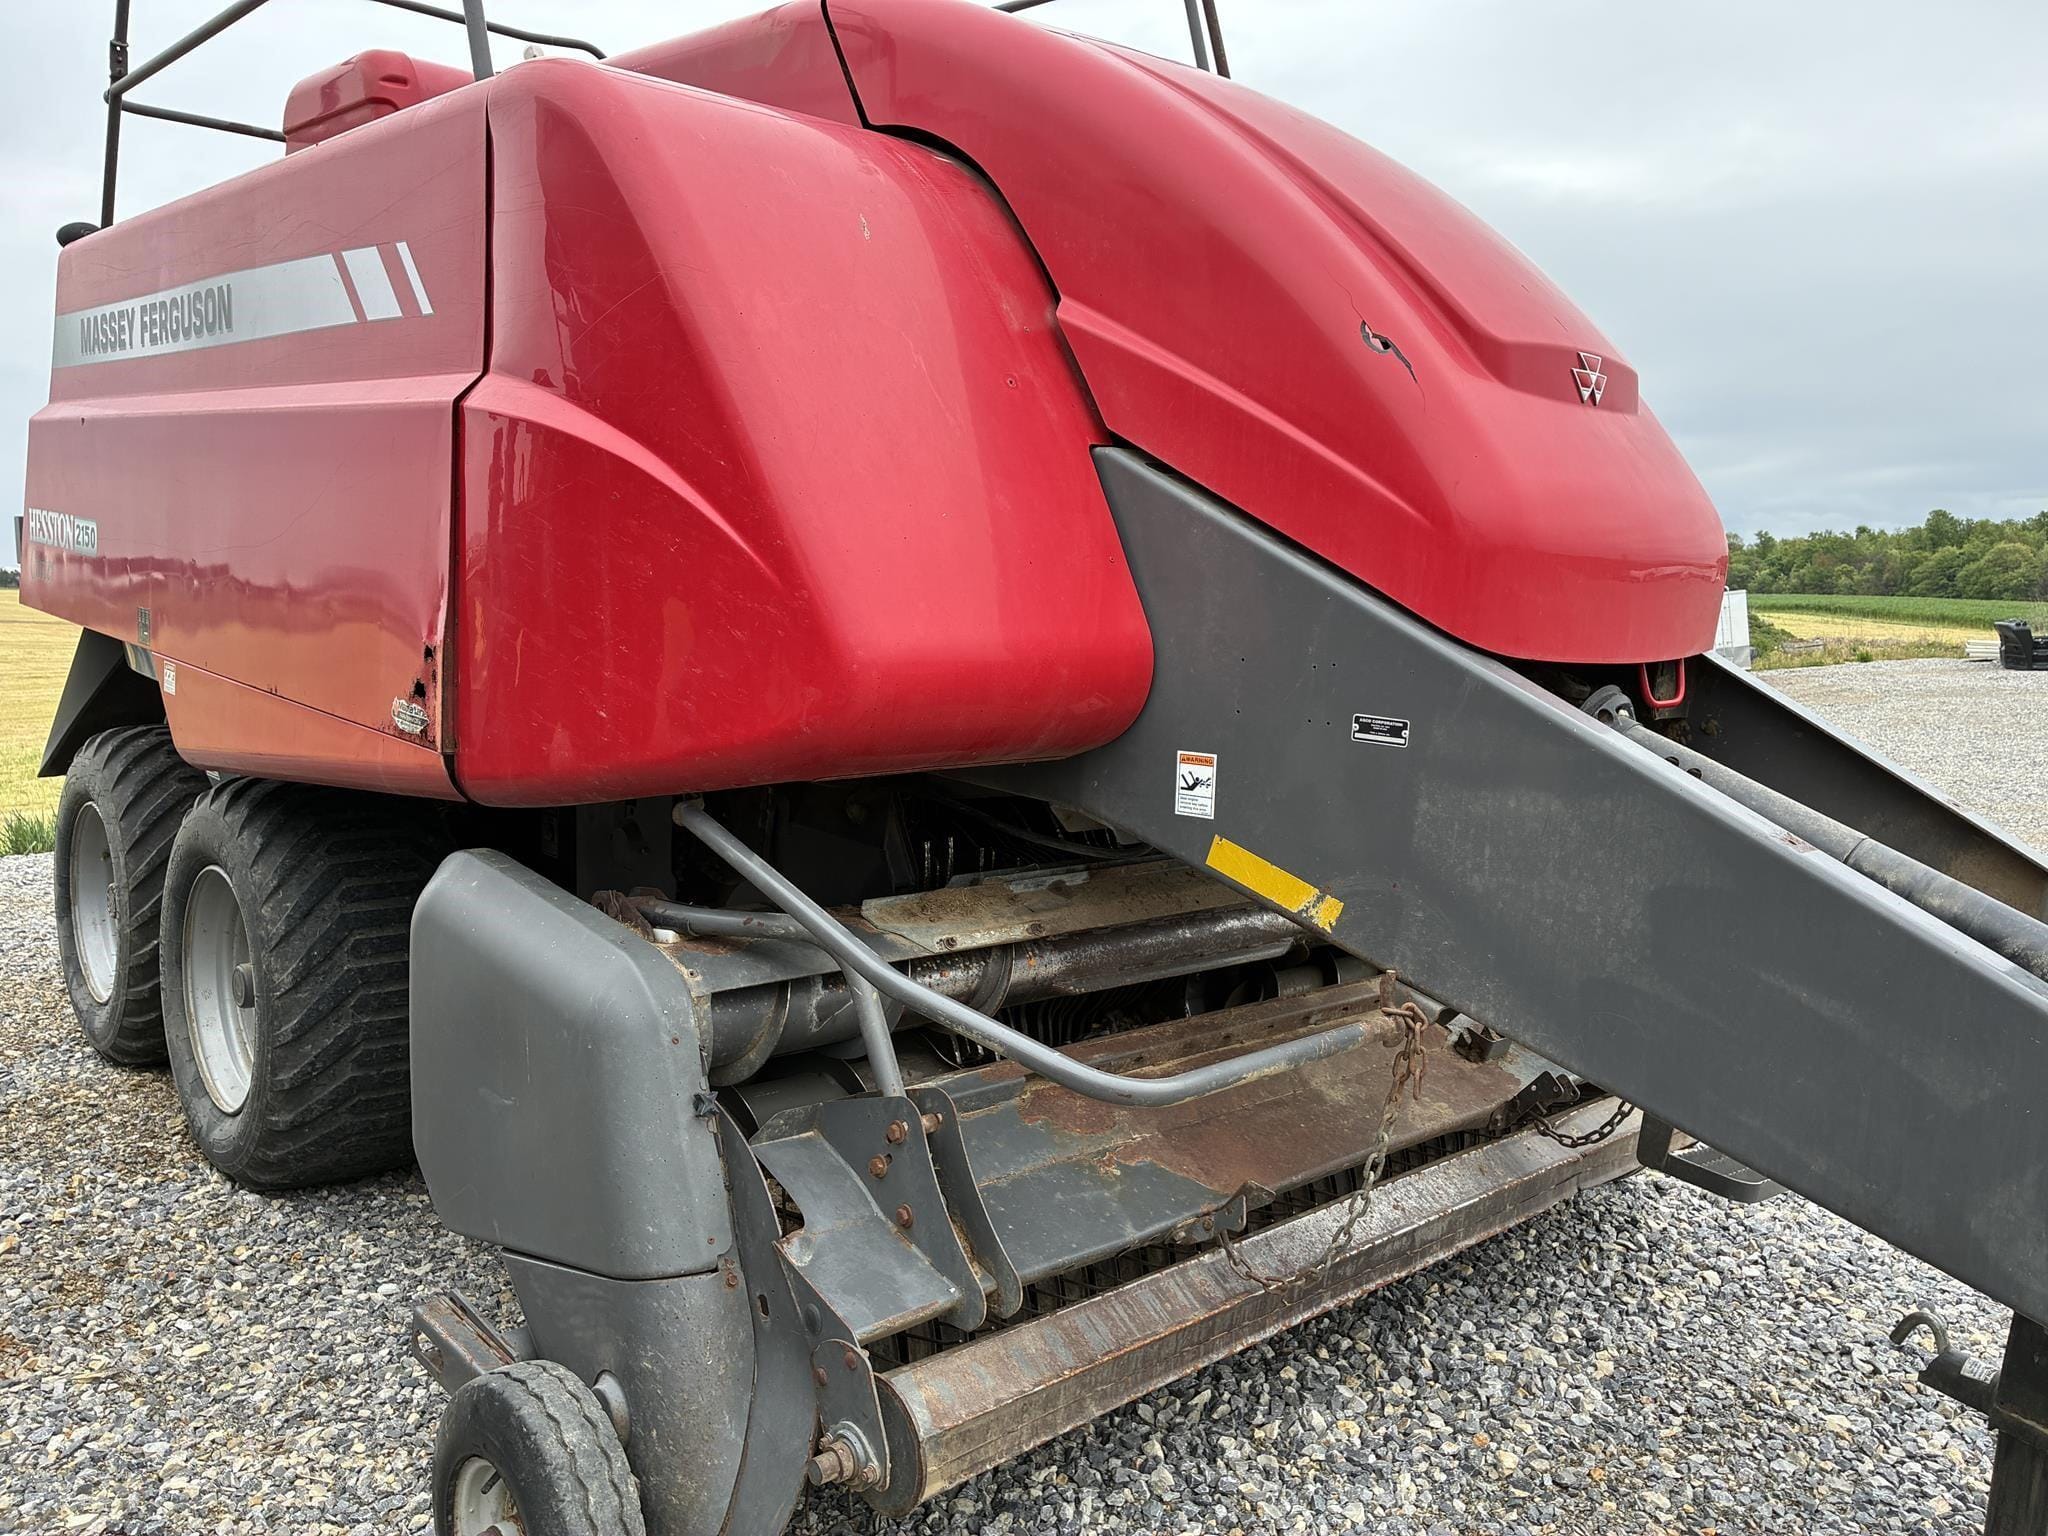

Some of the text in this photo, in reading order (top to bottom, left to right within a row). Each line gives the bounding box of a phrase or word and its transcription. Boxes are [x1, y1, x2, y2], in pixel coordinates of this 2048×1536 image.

[80, 283, 234, 357] MASSEY FERGUSON
[29, 507, 97, 551] HESSTON 2150
[1185, 756, 1213, 765] WARNING
